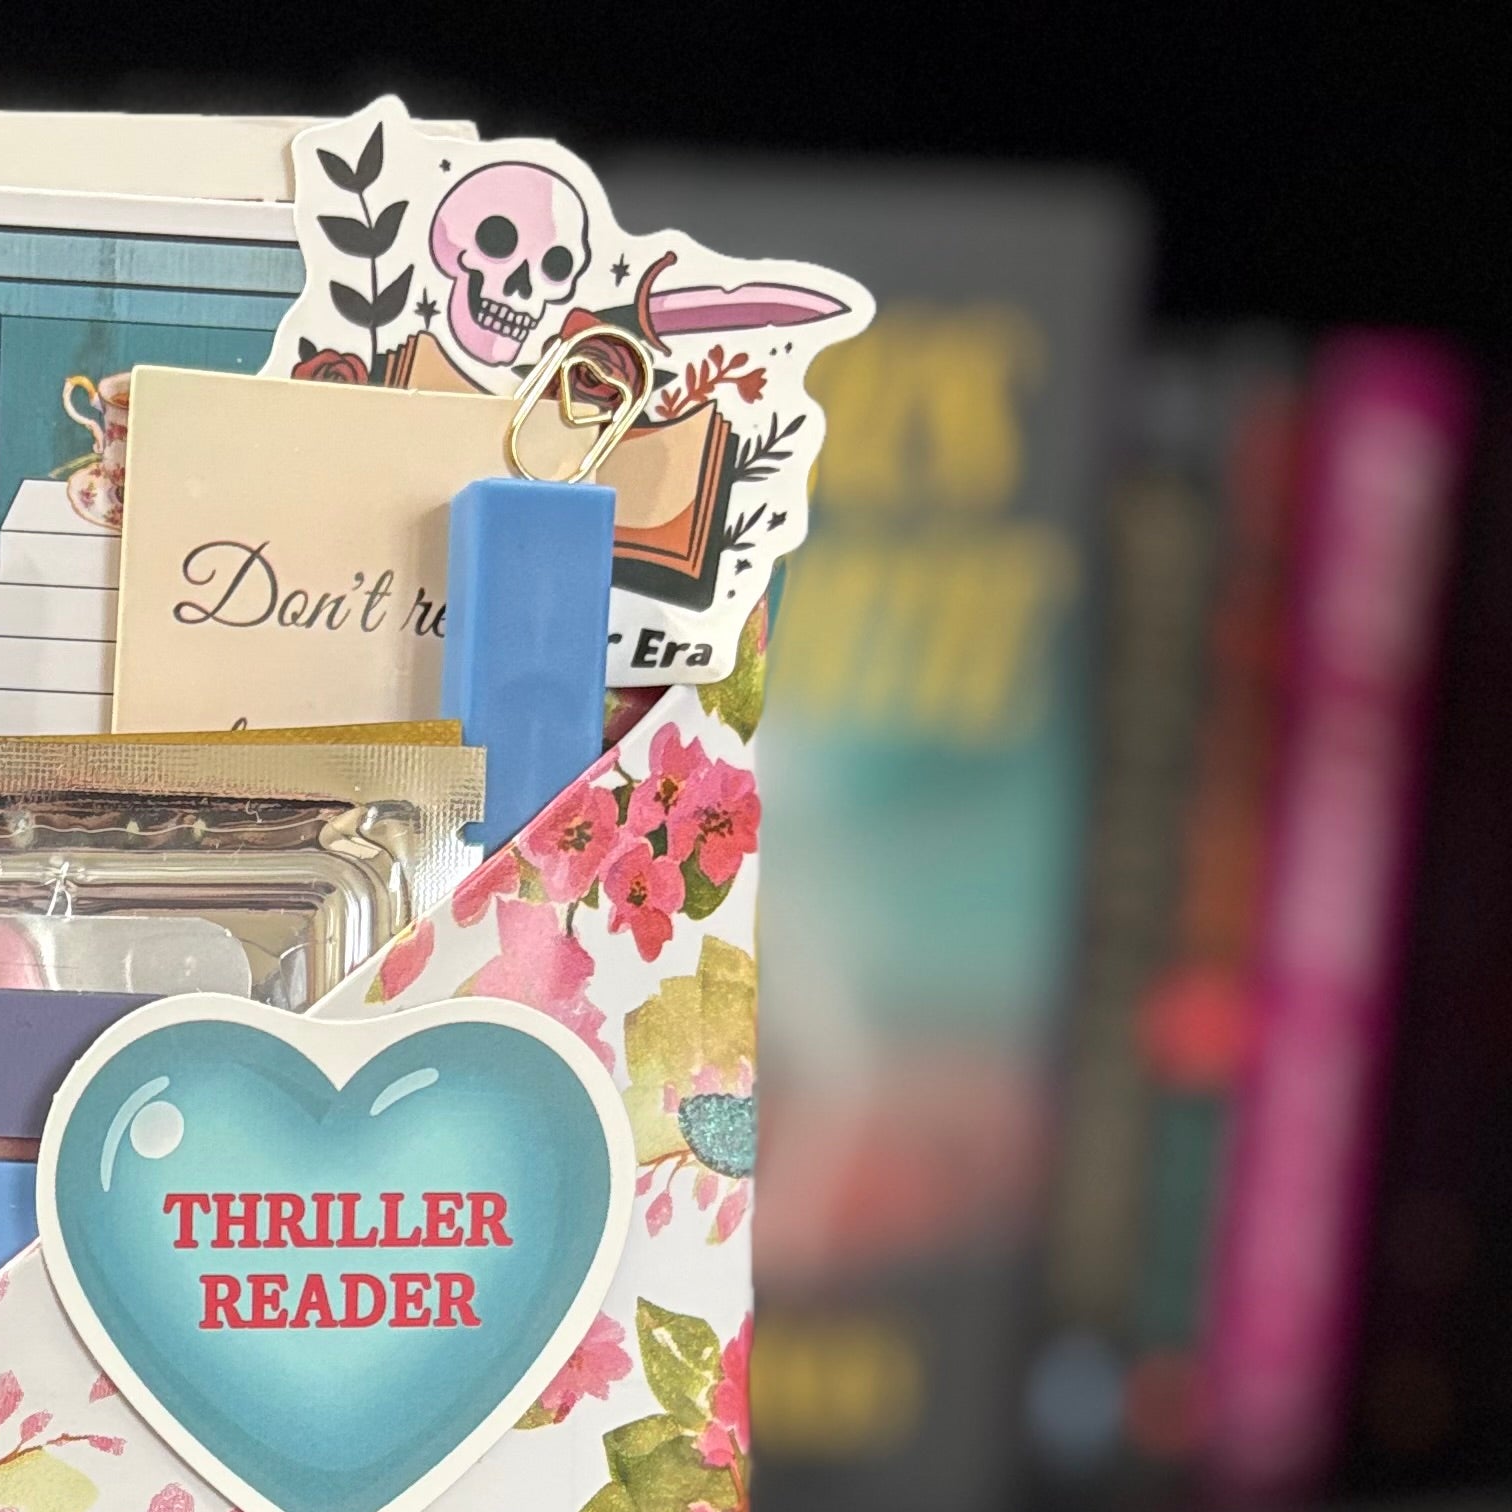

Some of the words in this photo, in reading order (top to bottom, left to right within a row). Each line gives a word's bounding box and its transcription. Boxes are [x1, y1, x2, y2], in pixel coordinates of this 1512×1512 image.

[173, 540, 394, 632] Don't
[630, 627, 714, 669] Era
[162, 1192, 514, 1249] THRILLER
[198, 1272, 482, 1330] READER
